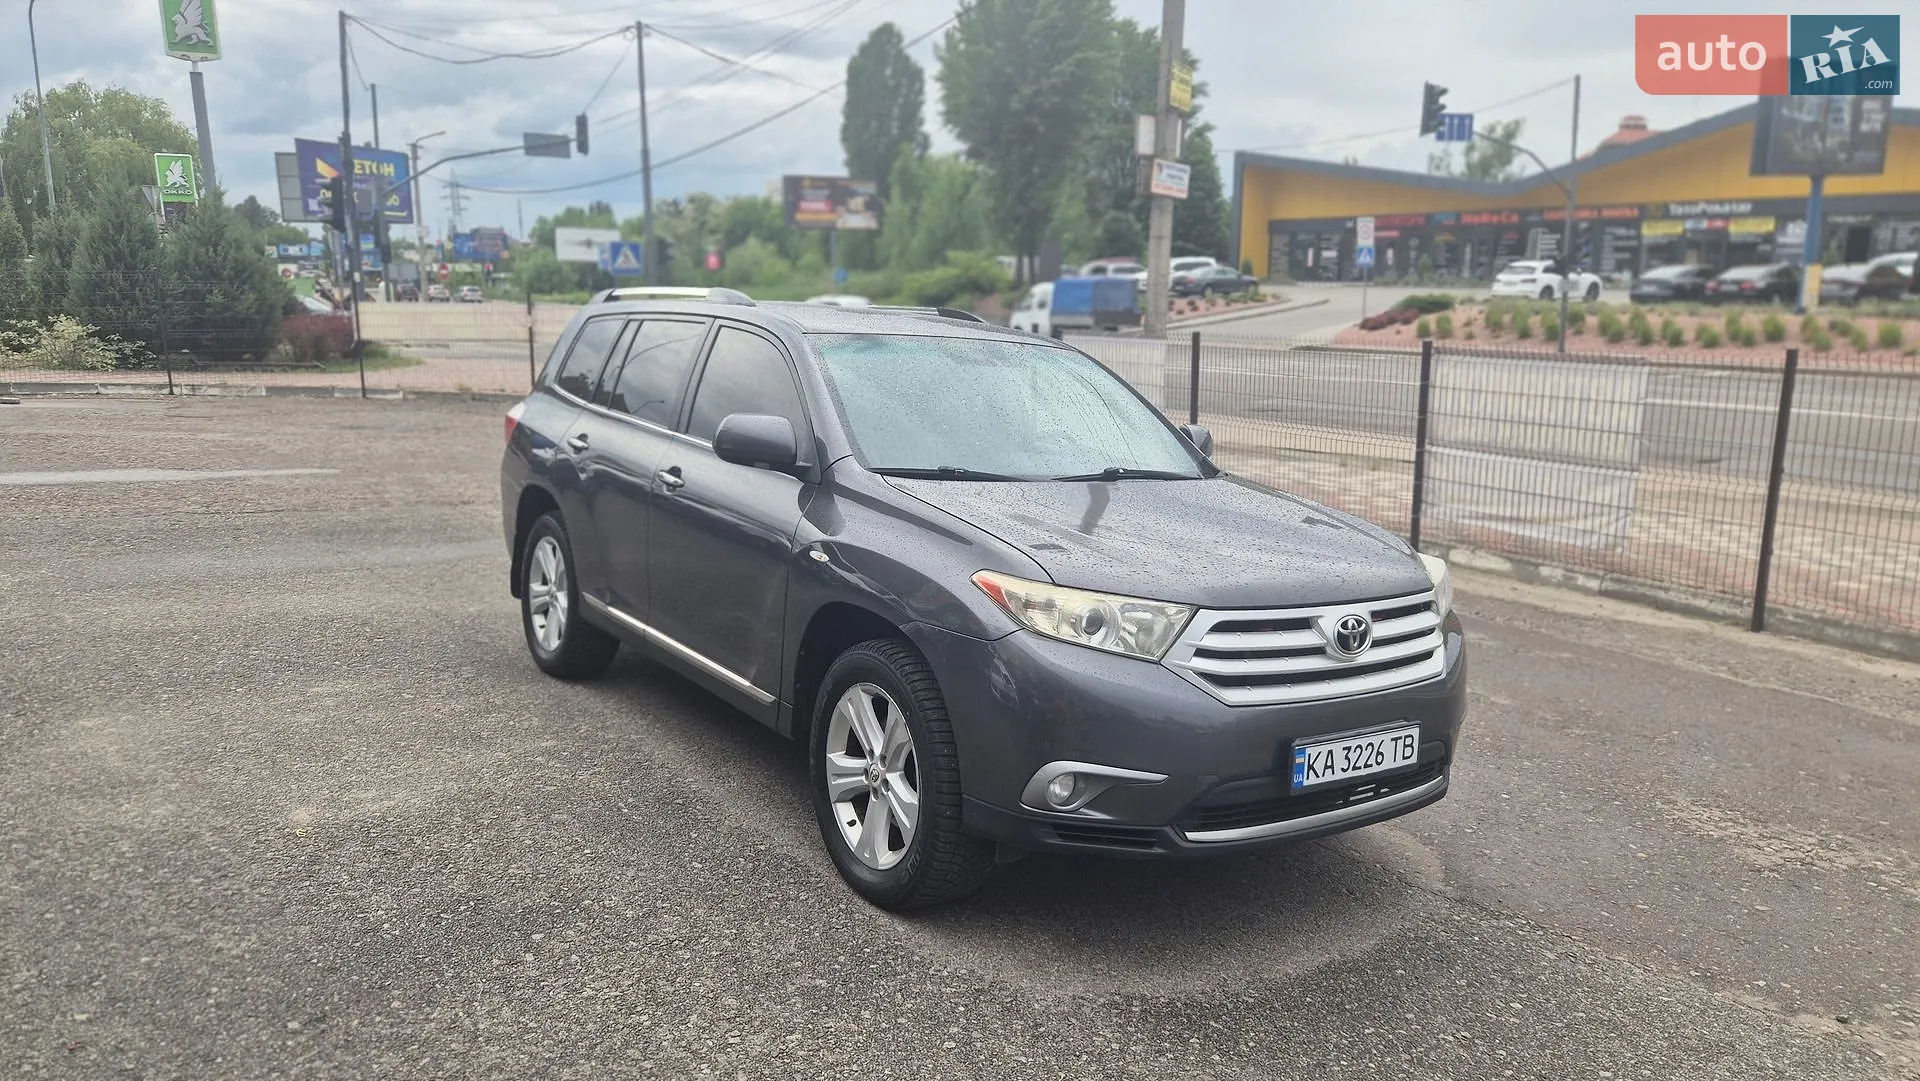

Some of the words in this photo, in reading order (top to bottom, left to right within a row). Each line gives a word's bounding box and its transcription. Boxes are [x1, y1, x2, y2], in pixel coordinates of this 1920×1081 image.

[1306, 749, 1335, 780] KA
[1340, 739, 1385, 773] 3226
[1391, 734, 1415, 762] TB
